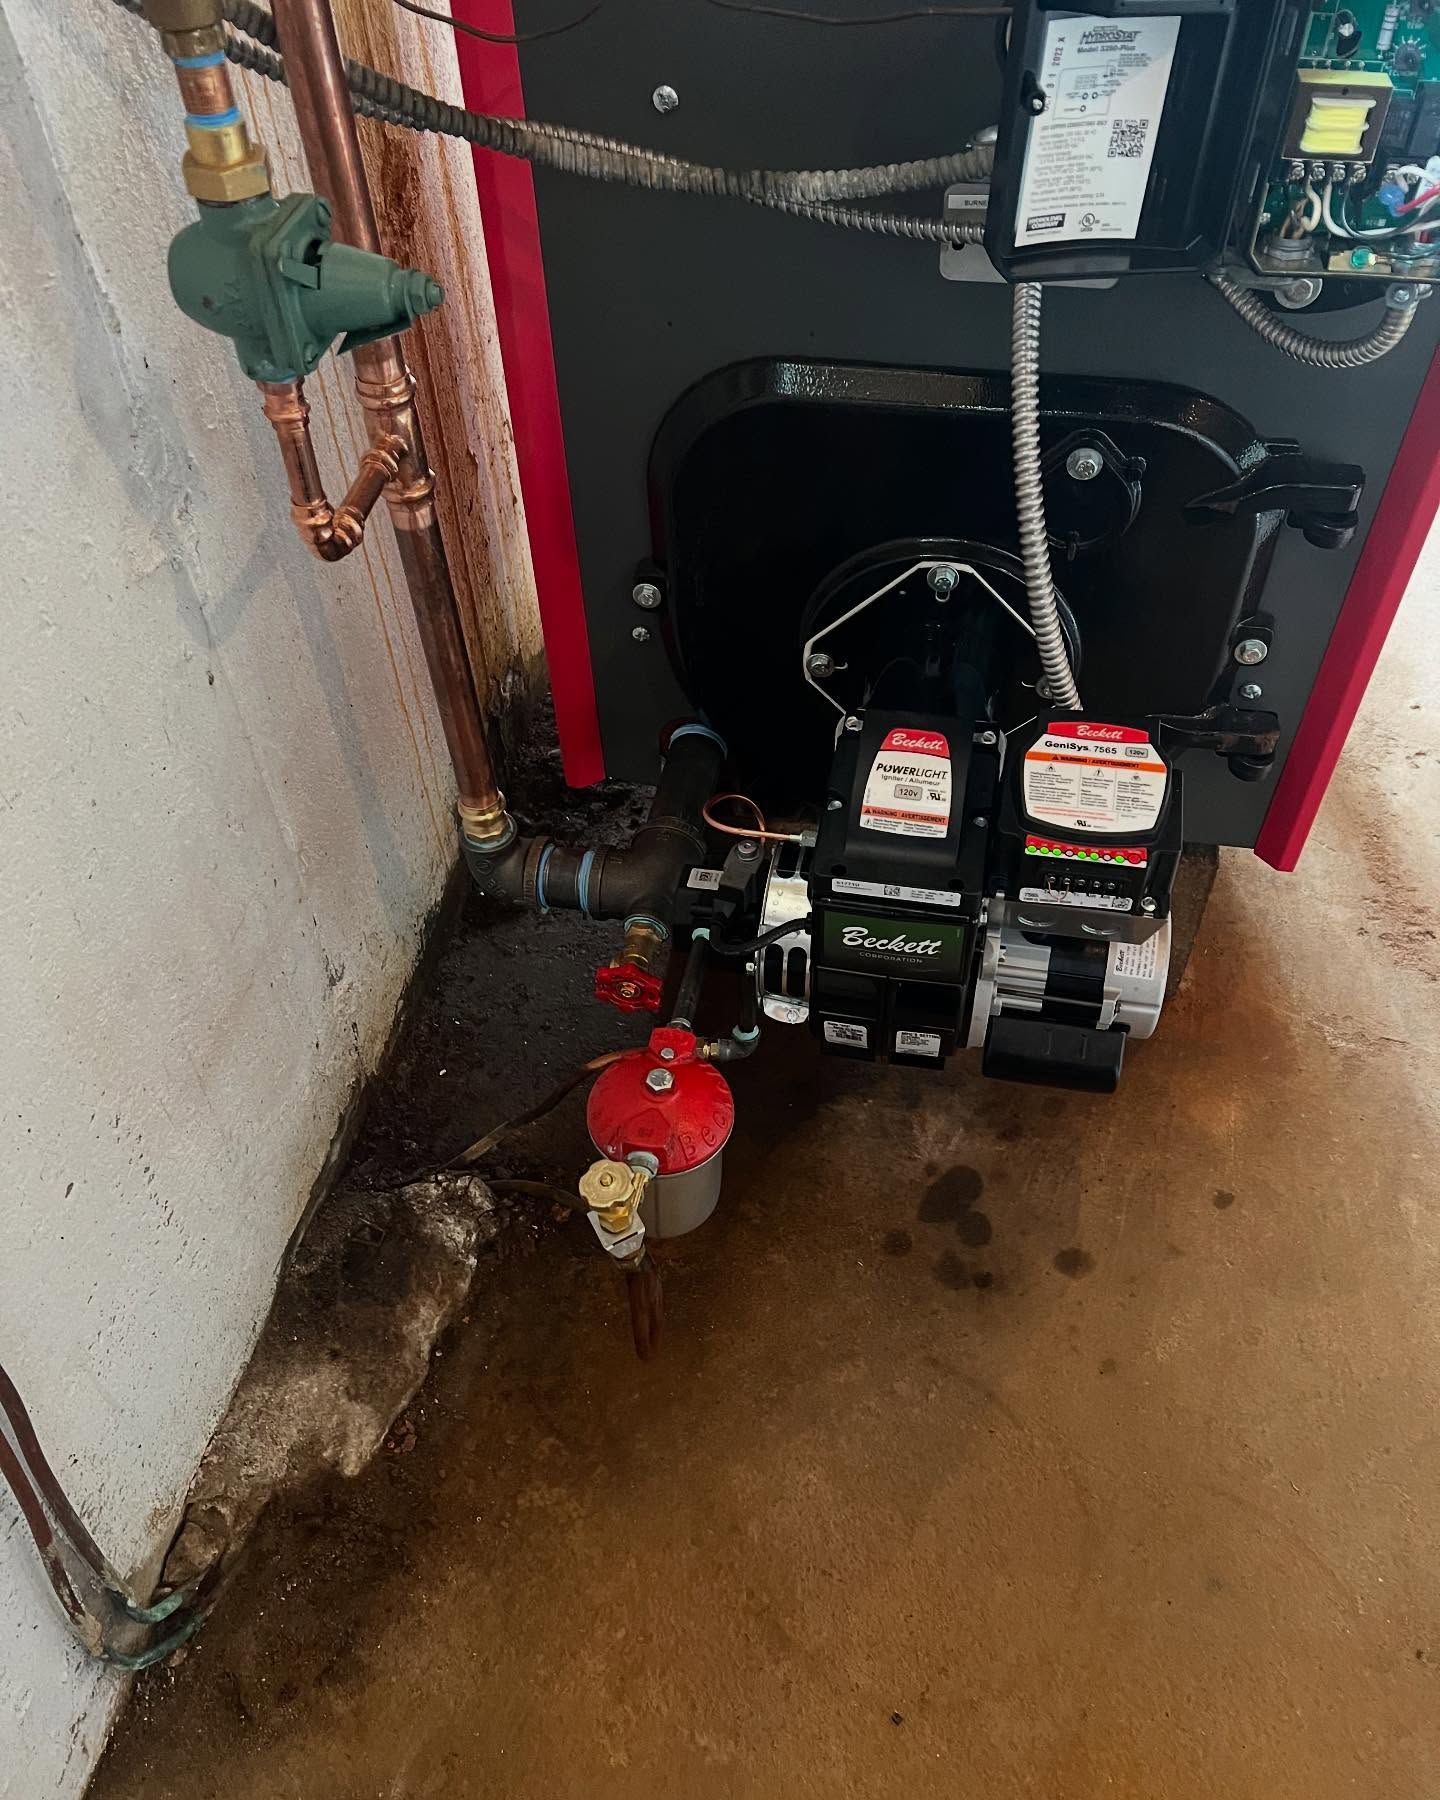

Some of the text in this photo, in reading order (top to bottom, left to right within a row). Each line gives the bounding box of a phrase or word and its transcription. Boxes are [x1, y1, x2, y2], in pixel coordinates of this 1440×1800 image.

[1052, 47, 1063, 66] 2022
[1076, 724, 1123, 740] Beckett
[892, 732, 944, 750] Beckett
[1045, 740, 1089, 752] GeniSys
[1094, 745, 1118, 755] 7565
[876, 763, 948, 780] POWERLIGHT
[881, 774, 904, 782] Igniter
[909, 777, 941, 786] Allumeur
[899, 788, 918, 797] 120v
[872, 809, 946, 824] WARNING AVERTISSEMENT
[842, 926, 943, 955] Beckett
[859, 951, 923, 964] CORPORATION
